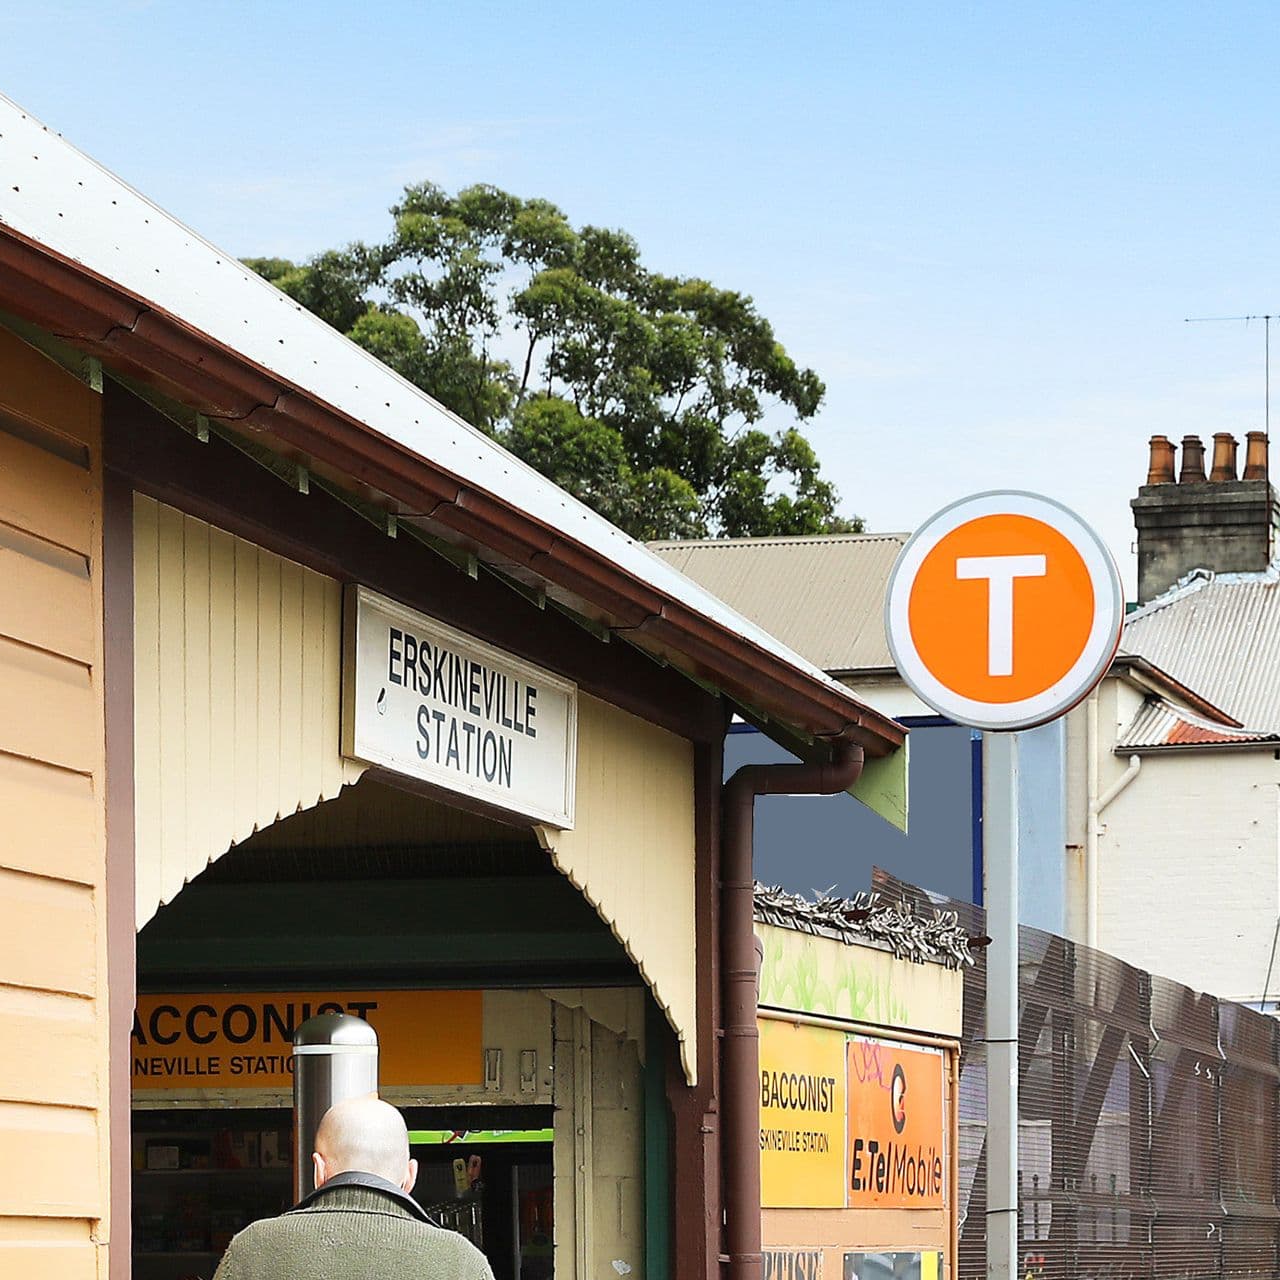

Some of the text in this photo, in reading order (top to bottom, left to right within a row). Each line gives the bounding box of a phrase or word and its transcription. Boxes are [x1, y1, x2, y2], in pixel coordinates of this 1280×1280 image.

[956, 554, 1046, 676] T
[389, 627, 537, 738] ERSKINEVILLE
[416, 704, 512, 788] STATION
[132, 1056, 221, 1076] NEVILLE
[761, 1070, 835, 1113] BACCONIST
[760, 1129, 829, 1153] SKINEVILLE STATION
